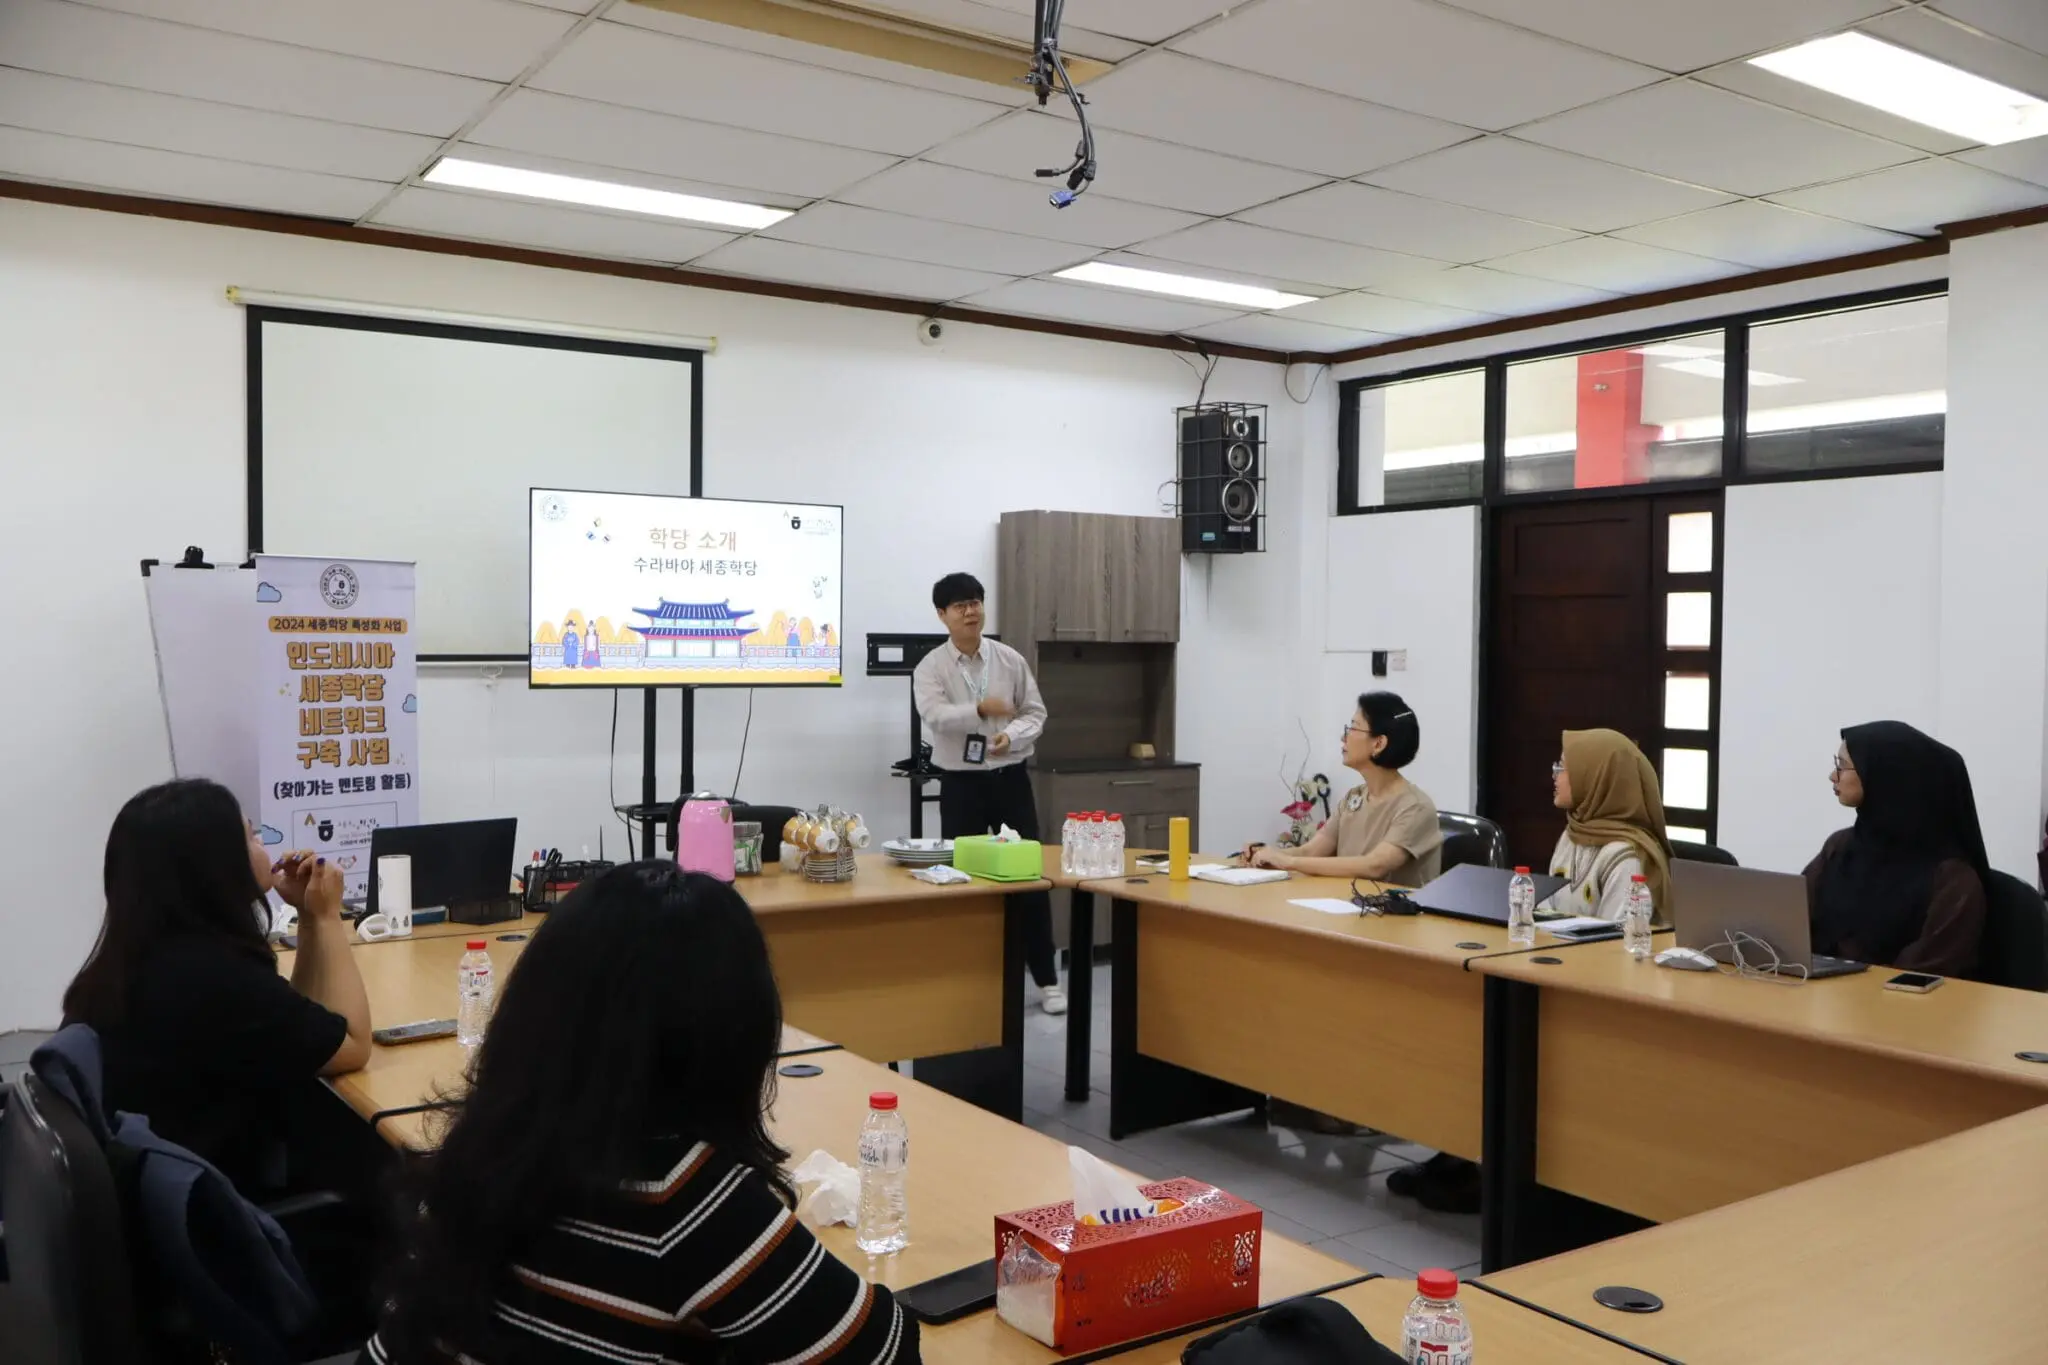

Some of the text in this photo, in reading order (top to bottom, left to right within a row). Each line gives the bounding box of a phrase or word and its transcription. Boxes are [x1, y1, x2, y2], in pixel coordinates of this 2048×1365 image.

[649, 527, 737, 552] 학당 소개
[633, 556, 758, 577] 수라바야 세종학당
[274, 618, 402, 632] 2024 세종학당 특성화 사업
[286, 641, 396, 670] 인도네시아
[299, 673, 387, 703] 세종학당
[299, 706, 387, 736] 네트워크
[296, 737, 390, 769] 구축 사업
[273, 772, 411, 800] (찾아가는 멘토링 활동)
